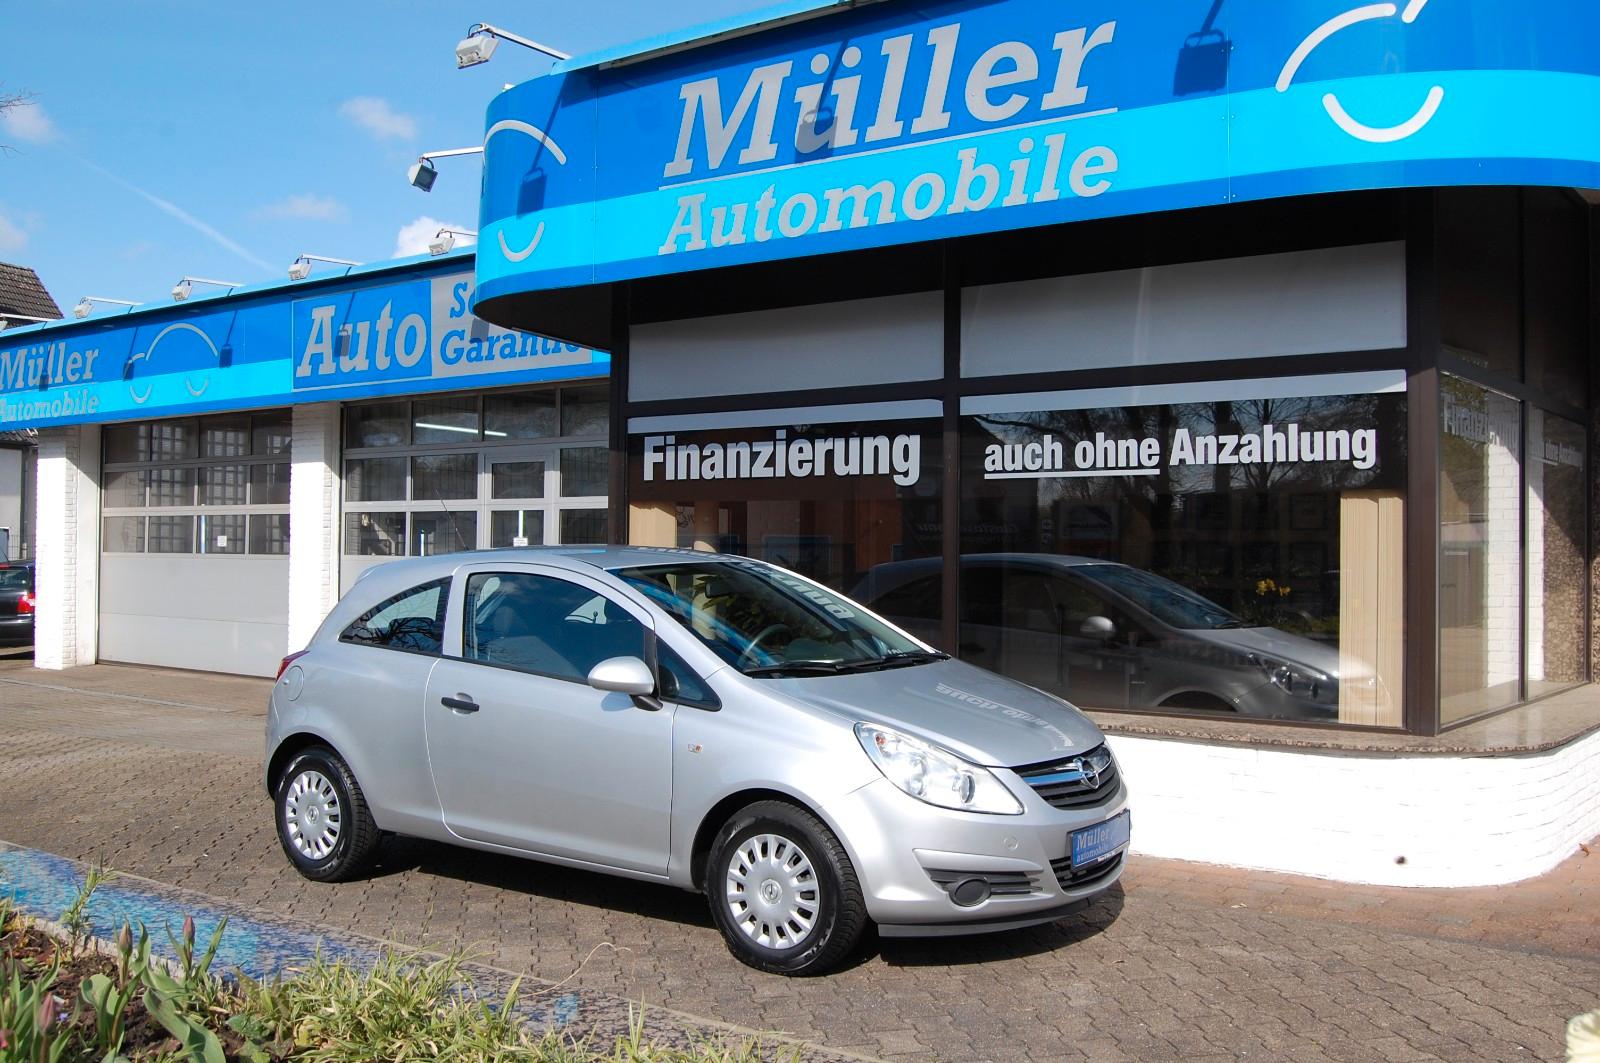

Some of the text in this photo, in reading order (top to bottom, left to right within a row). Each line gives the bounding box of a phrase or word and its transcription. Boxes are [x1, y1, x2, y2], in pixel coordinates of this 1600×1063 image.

[663, 20, 1117, 178] Müller
[658, 133, 1118, 256] Automobile
[0, 342, 99, 390] Müller
[296, 299, 427, 377] Auto
[643, 429, 921, 486] Finanzierung
[985, 424, 1376, 471] auch ohne Anzahlung
[1077, 828, 1109, 850] Müller
